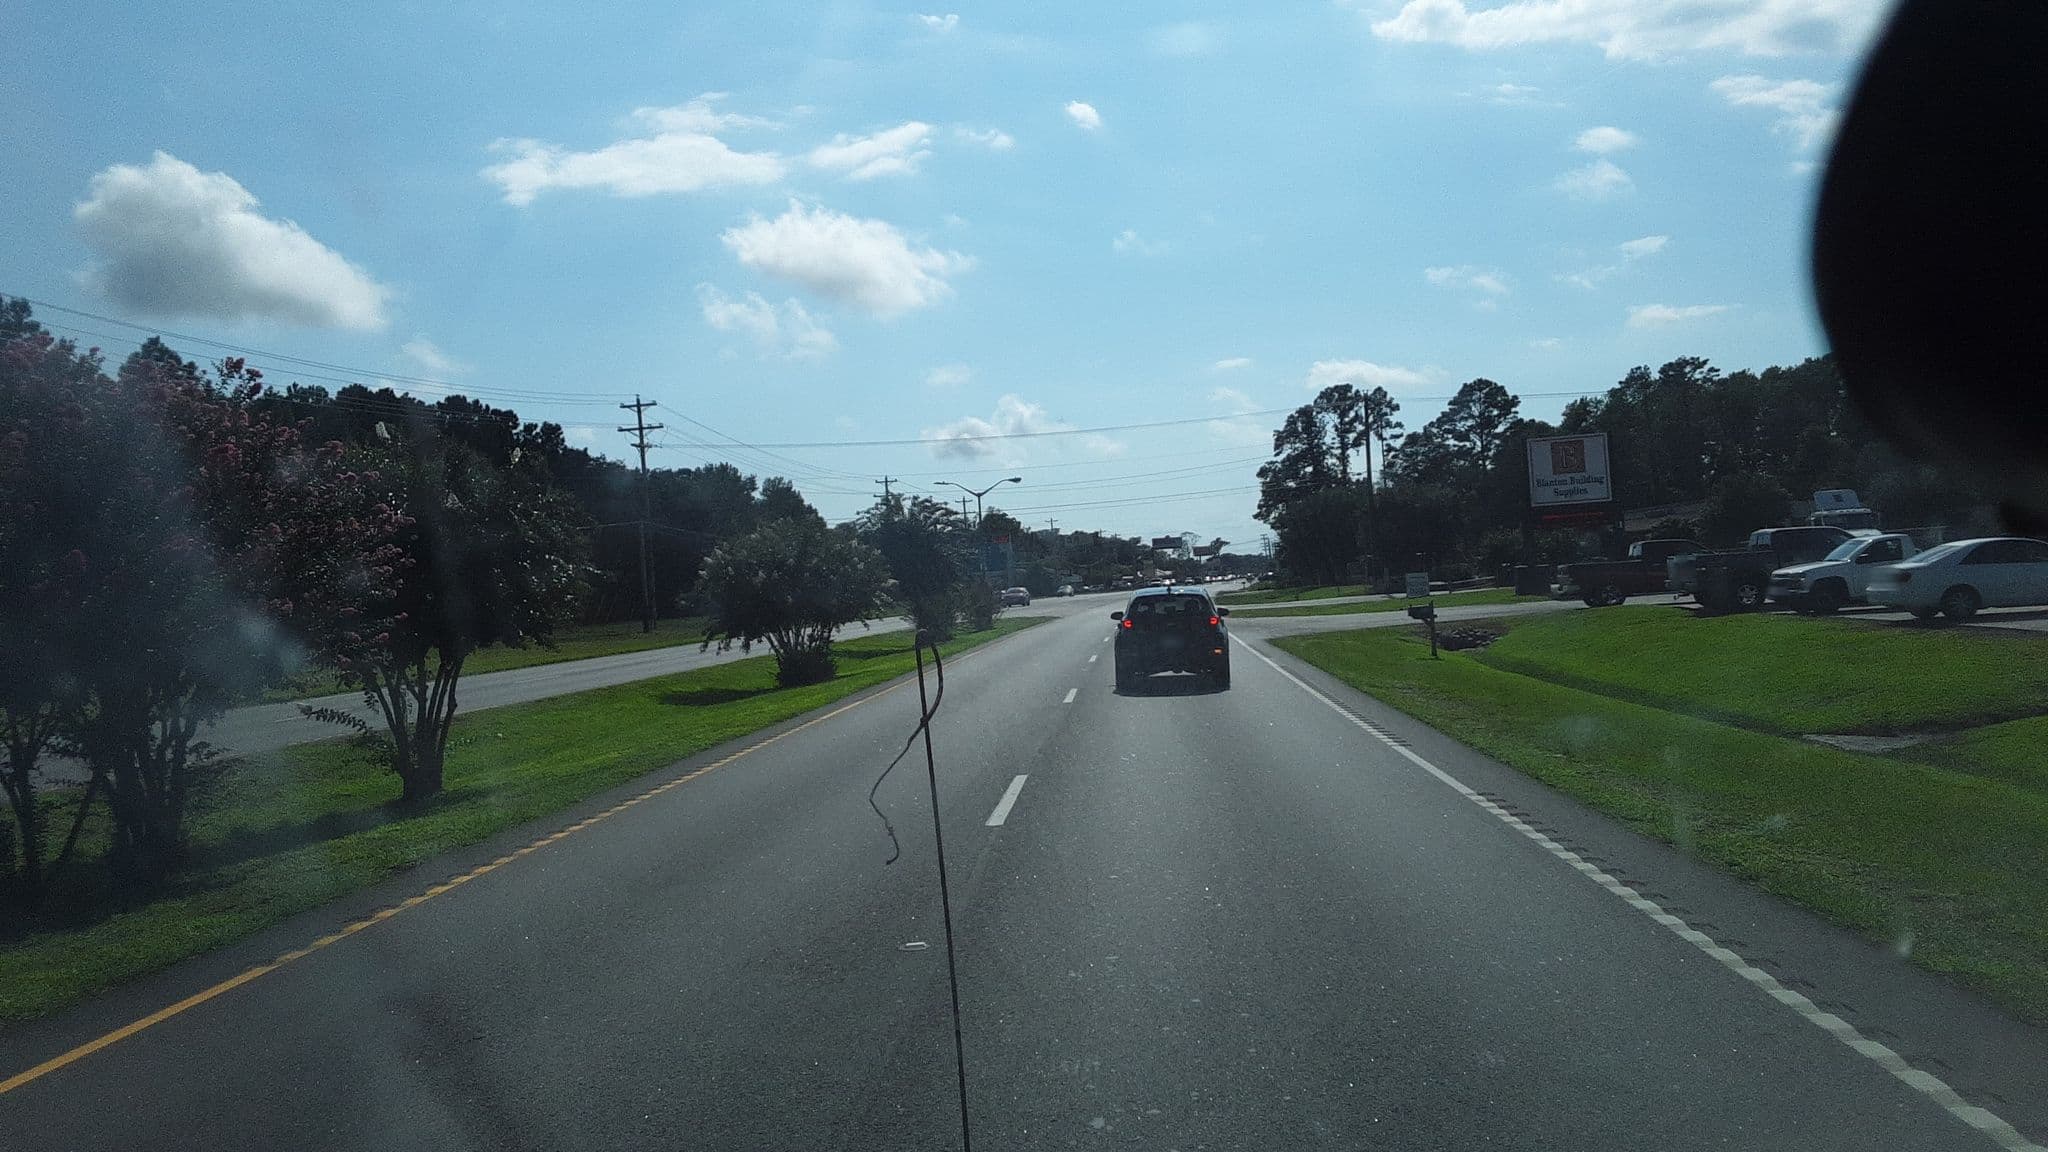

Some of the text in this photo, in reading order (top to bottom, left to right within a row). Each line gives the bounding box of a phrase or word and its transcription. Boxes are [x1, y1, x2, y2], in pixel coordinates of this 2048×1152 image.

[1536, 474, 1605, 488] Blanton Building
[1553, 486, 1589, 498] Supplies
